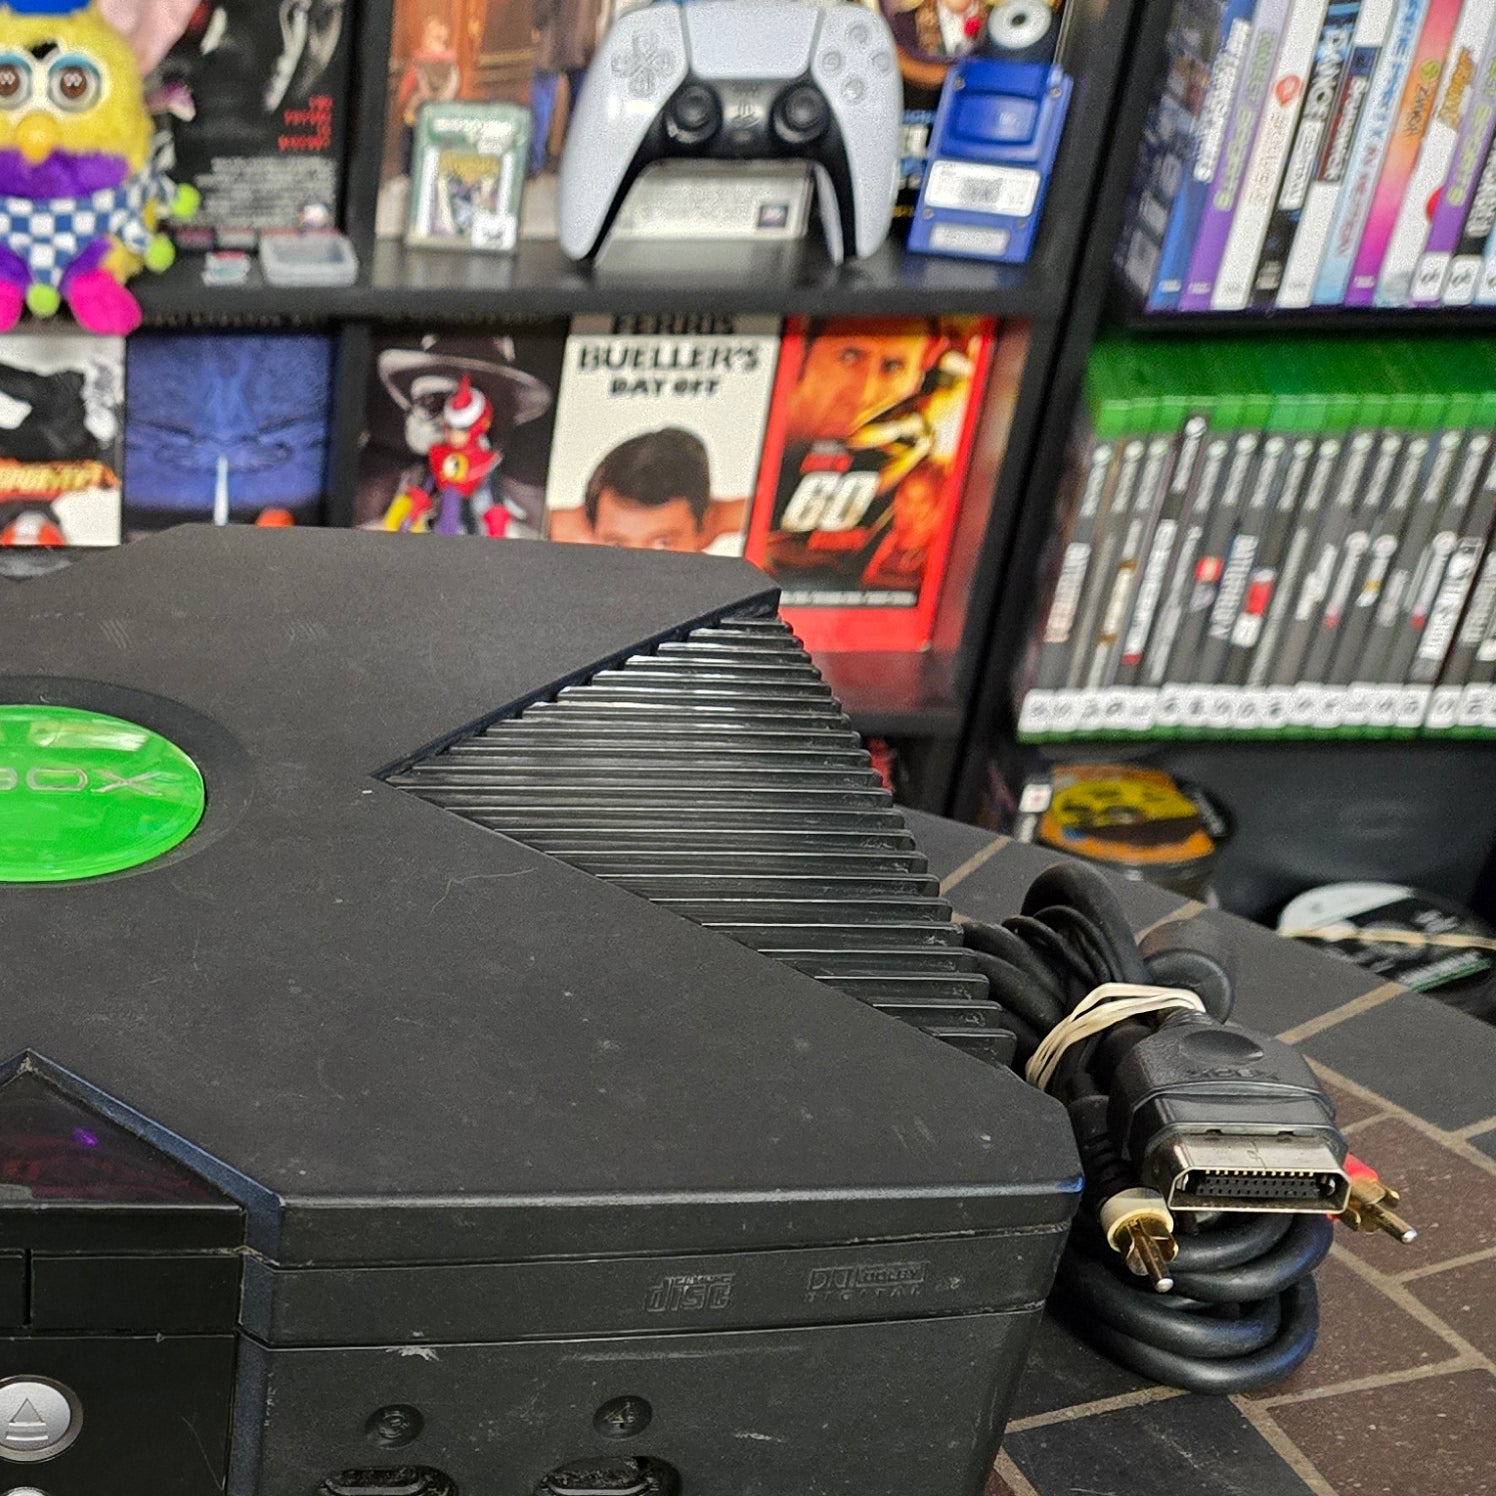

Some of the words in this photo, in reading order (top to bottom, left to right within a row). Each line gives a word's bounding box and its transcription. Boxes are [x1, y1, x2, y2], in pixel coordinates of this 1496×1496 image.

[579, 345, 758, 370] BUELLER'S
[611, 377, 667, 395] DAY
[673, 377, 719, 395] OFF
